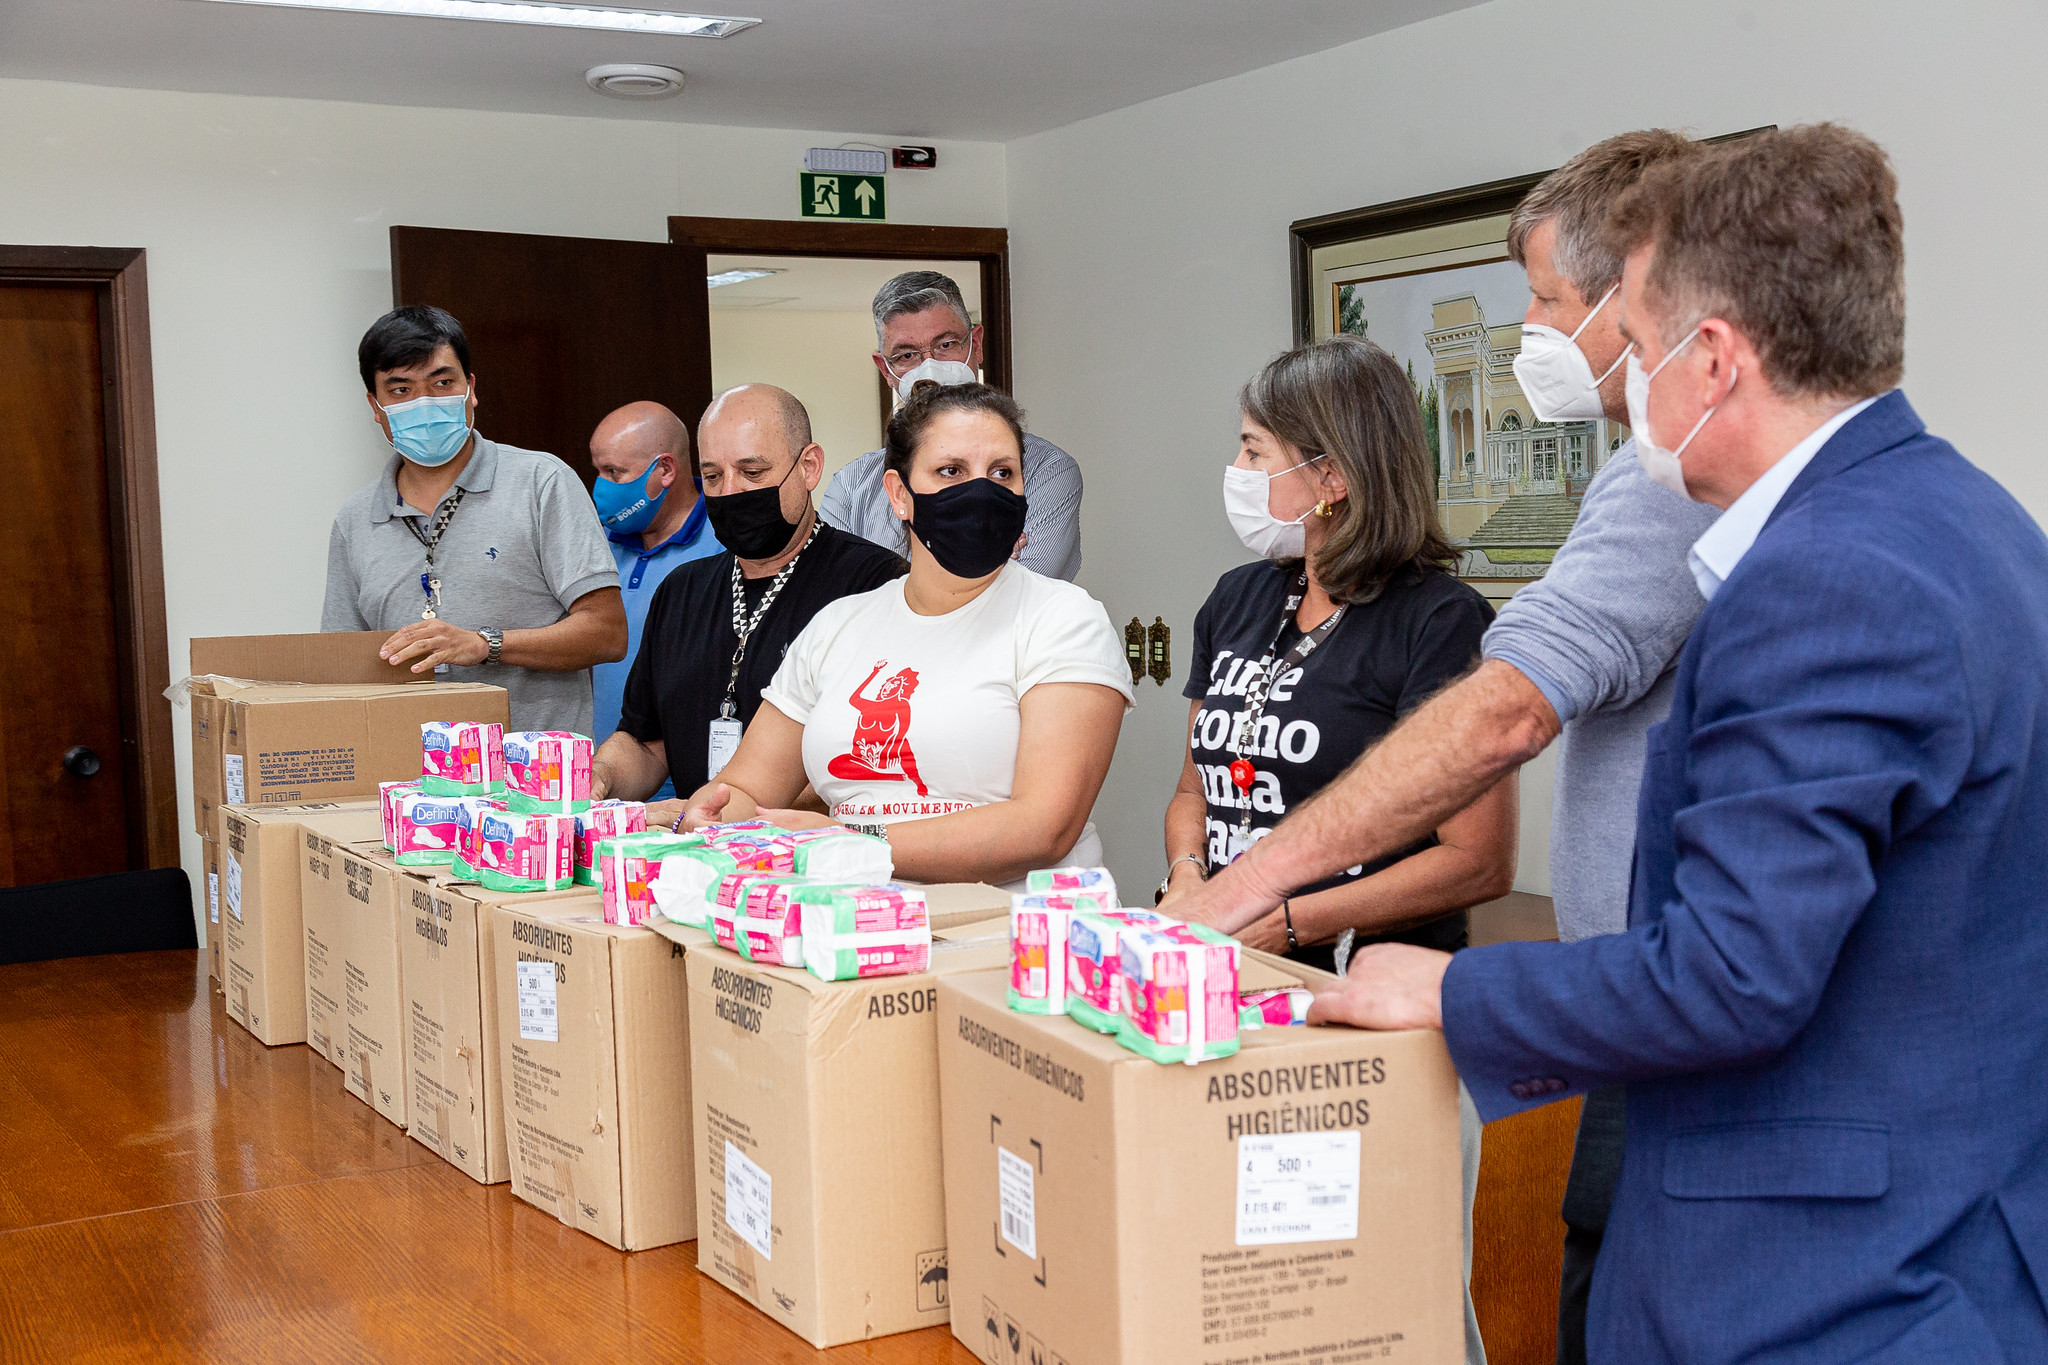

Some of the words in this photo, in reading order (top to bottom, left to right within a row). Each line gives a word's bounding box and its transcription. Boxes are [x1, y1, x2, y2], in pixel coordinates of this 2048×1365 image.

[617, 499, 646, 521] BOBATO
[1191, 709, 1320, 763] como
[882, 802, 972, 815] MOVIMENTO
[485, 820, 510, 842] Definity
[512, 920, 572, 956] ABSORVENTES
[711, 966, 772, 1009] ABSORVENTES
[959, 1015, 1021, 1070] ABSORVENTES
[1024, 1049, 1085, 1103] HIGIÊNICOS
[1207, 1057, 1386, 1103] ABSORVENTES
[1227, 1100, 1370, 1141] HIGIÊNICOS
[1246, 1160, 1253, 1172] 4
[1278, 1158, 1301, 1173] 500
